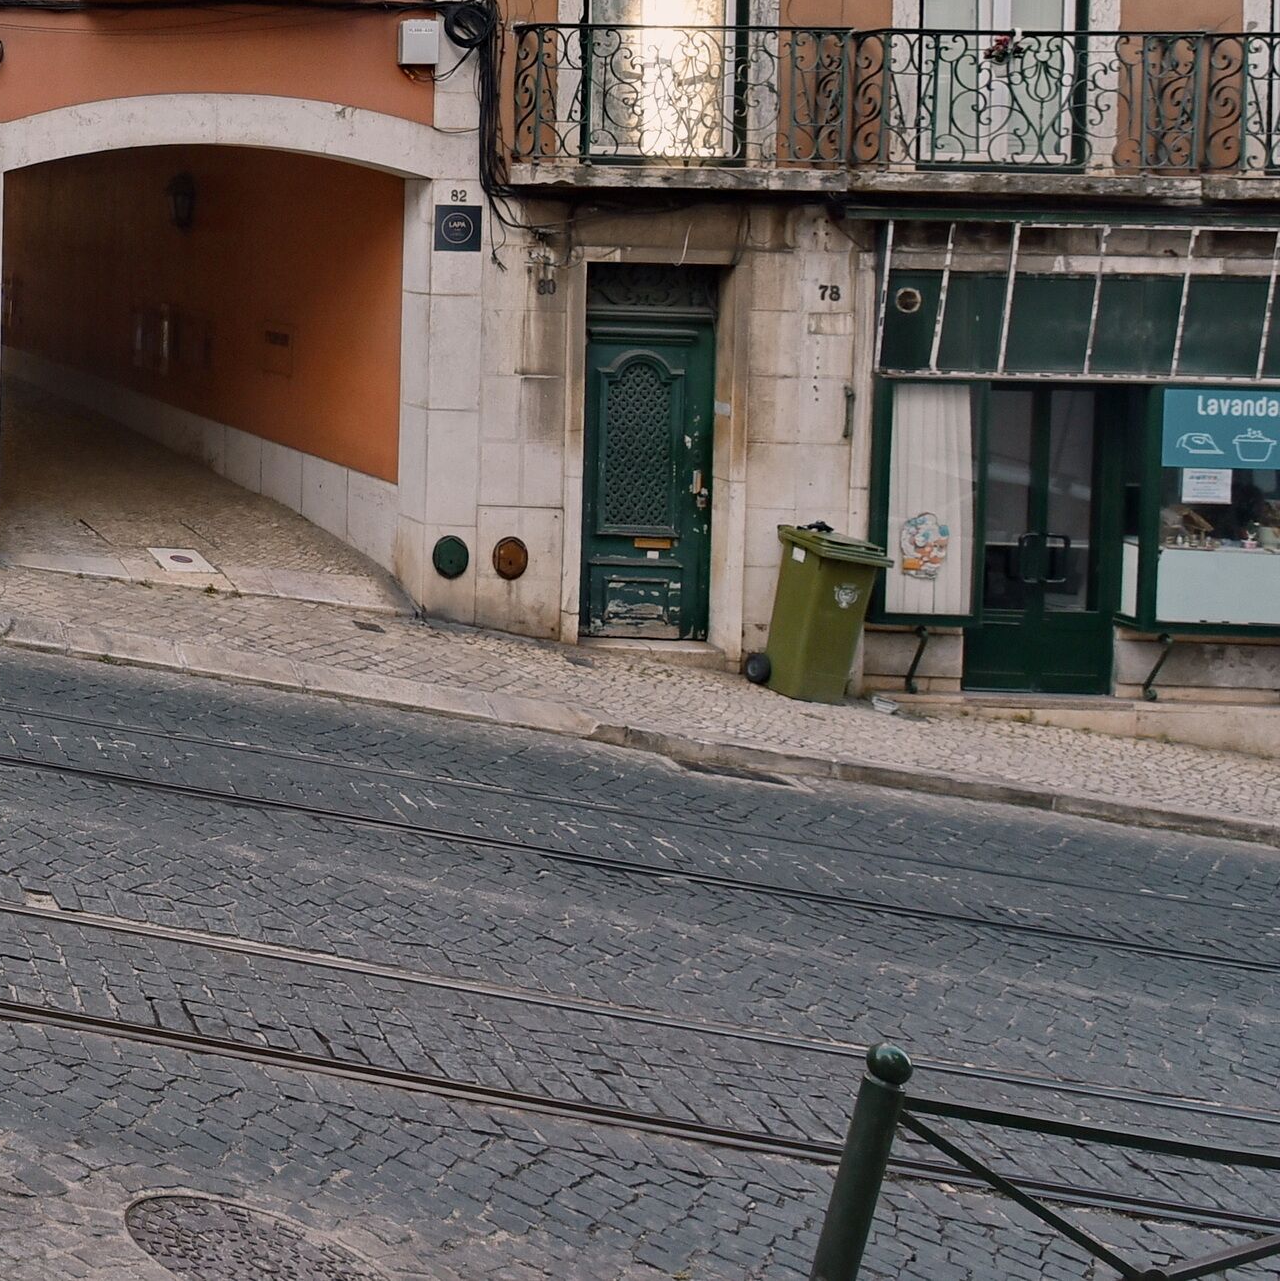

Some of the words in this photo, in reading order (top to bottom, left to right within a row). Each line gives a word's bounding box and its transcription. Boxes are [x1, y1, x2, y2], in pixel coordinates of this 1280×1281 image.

[450, 189, 467, 202] 82
[818, 284, 841, 302] 78
[1197, 395, 1280, 417] Lavanda
